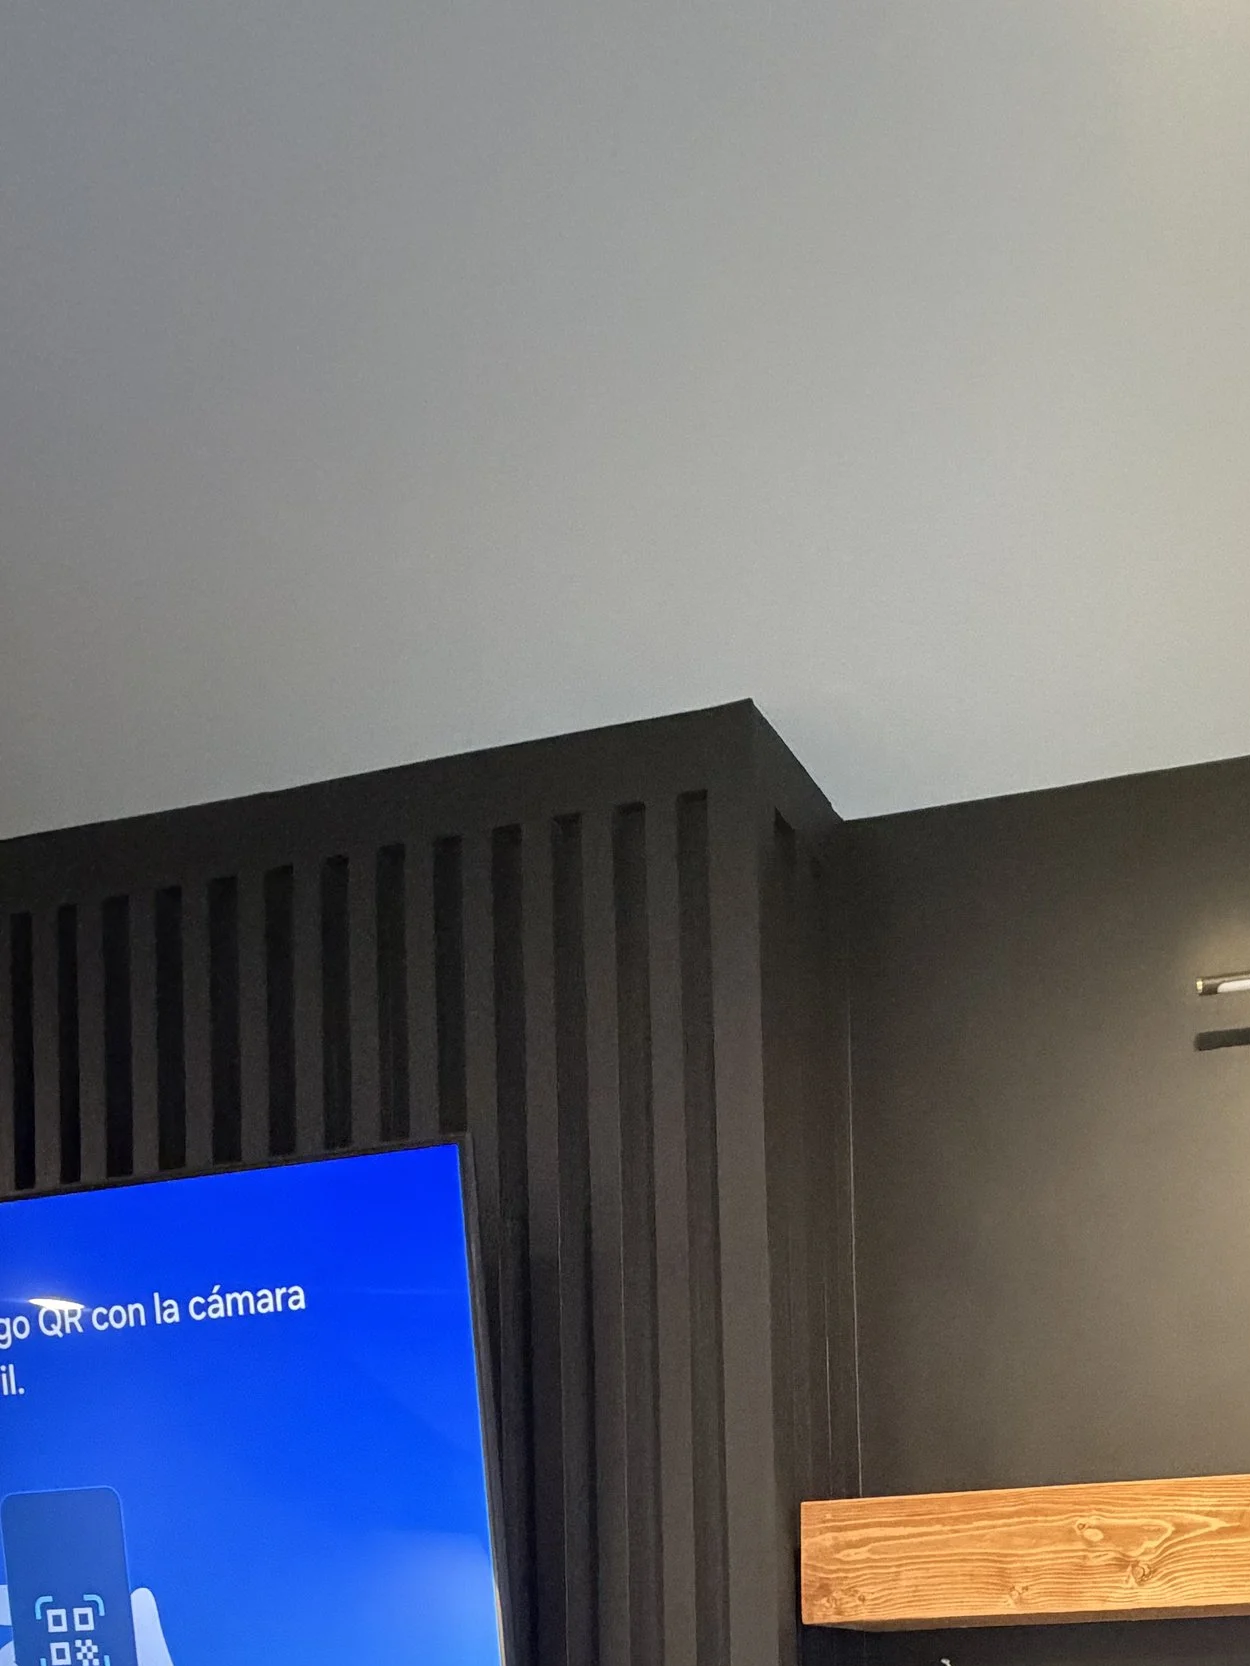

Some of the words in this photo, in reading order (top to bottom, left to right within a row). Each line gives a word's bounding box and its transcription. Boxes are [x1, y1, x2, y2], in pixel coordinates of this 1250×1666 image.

[38, 1306, 84, 1338] QR
[91, 1302, 146, 1331] con
[153, 1292, 180, 1325] la
[188, 1284, 306, 1321] cámara
